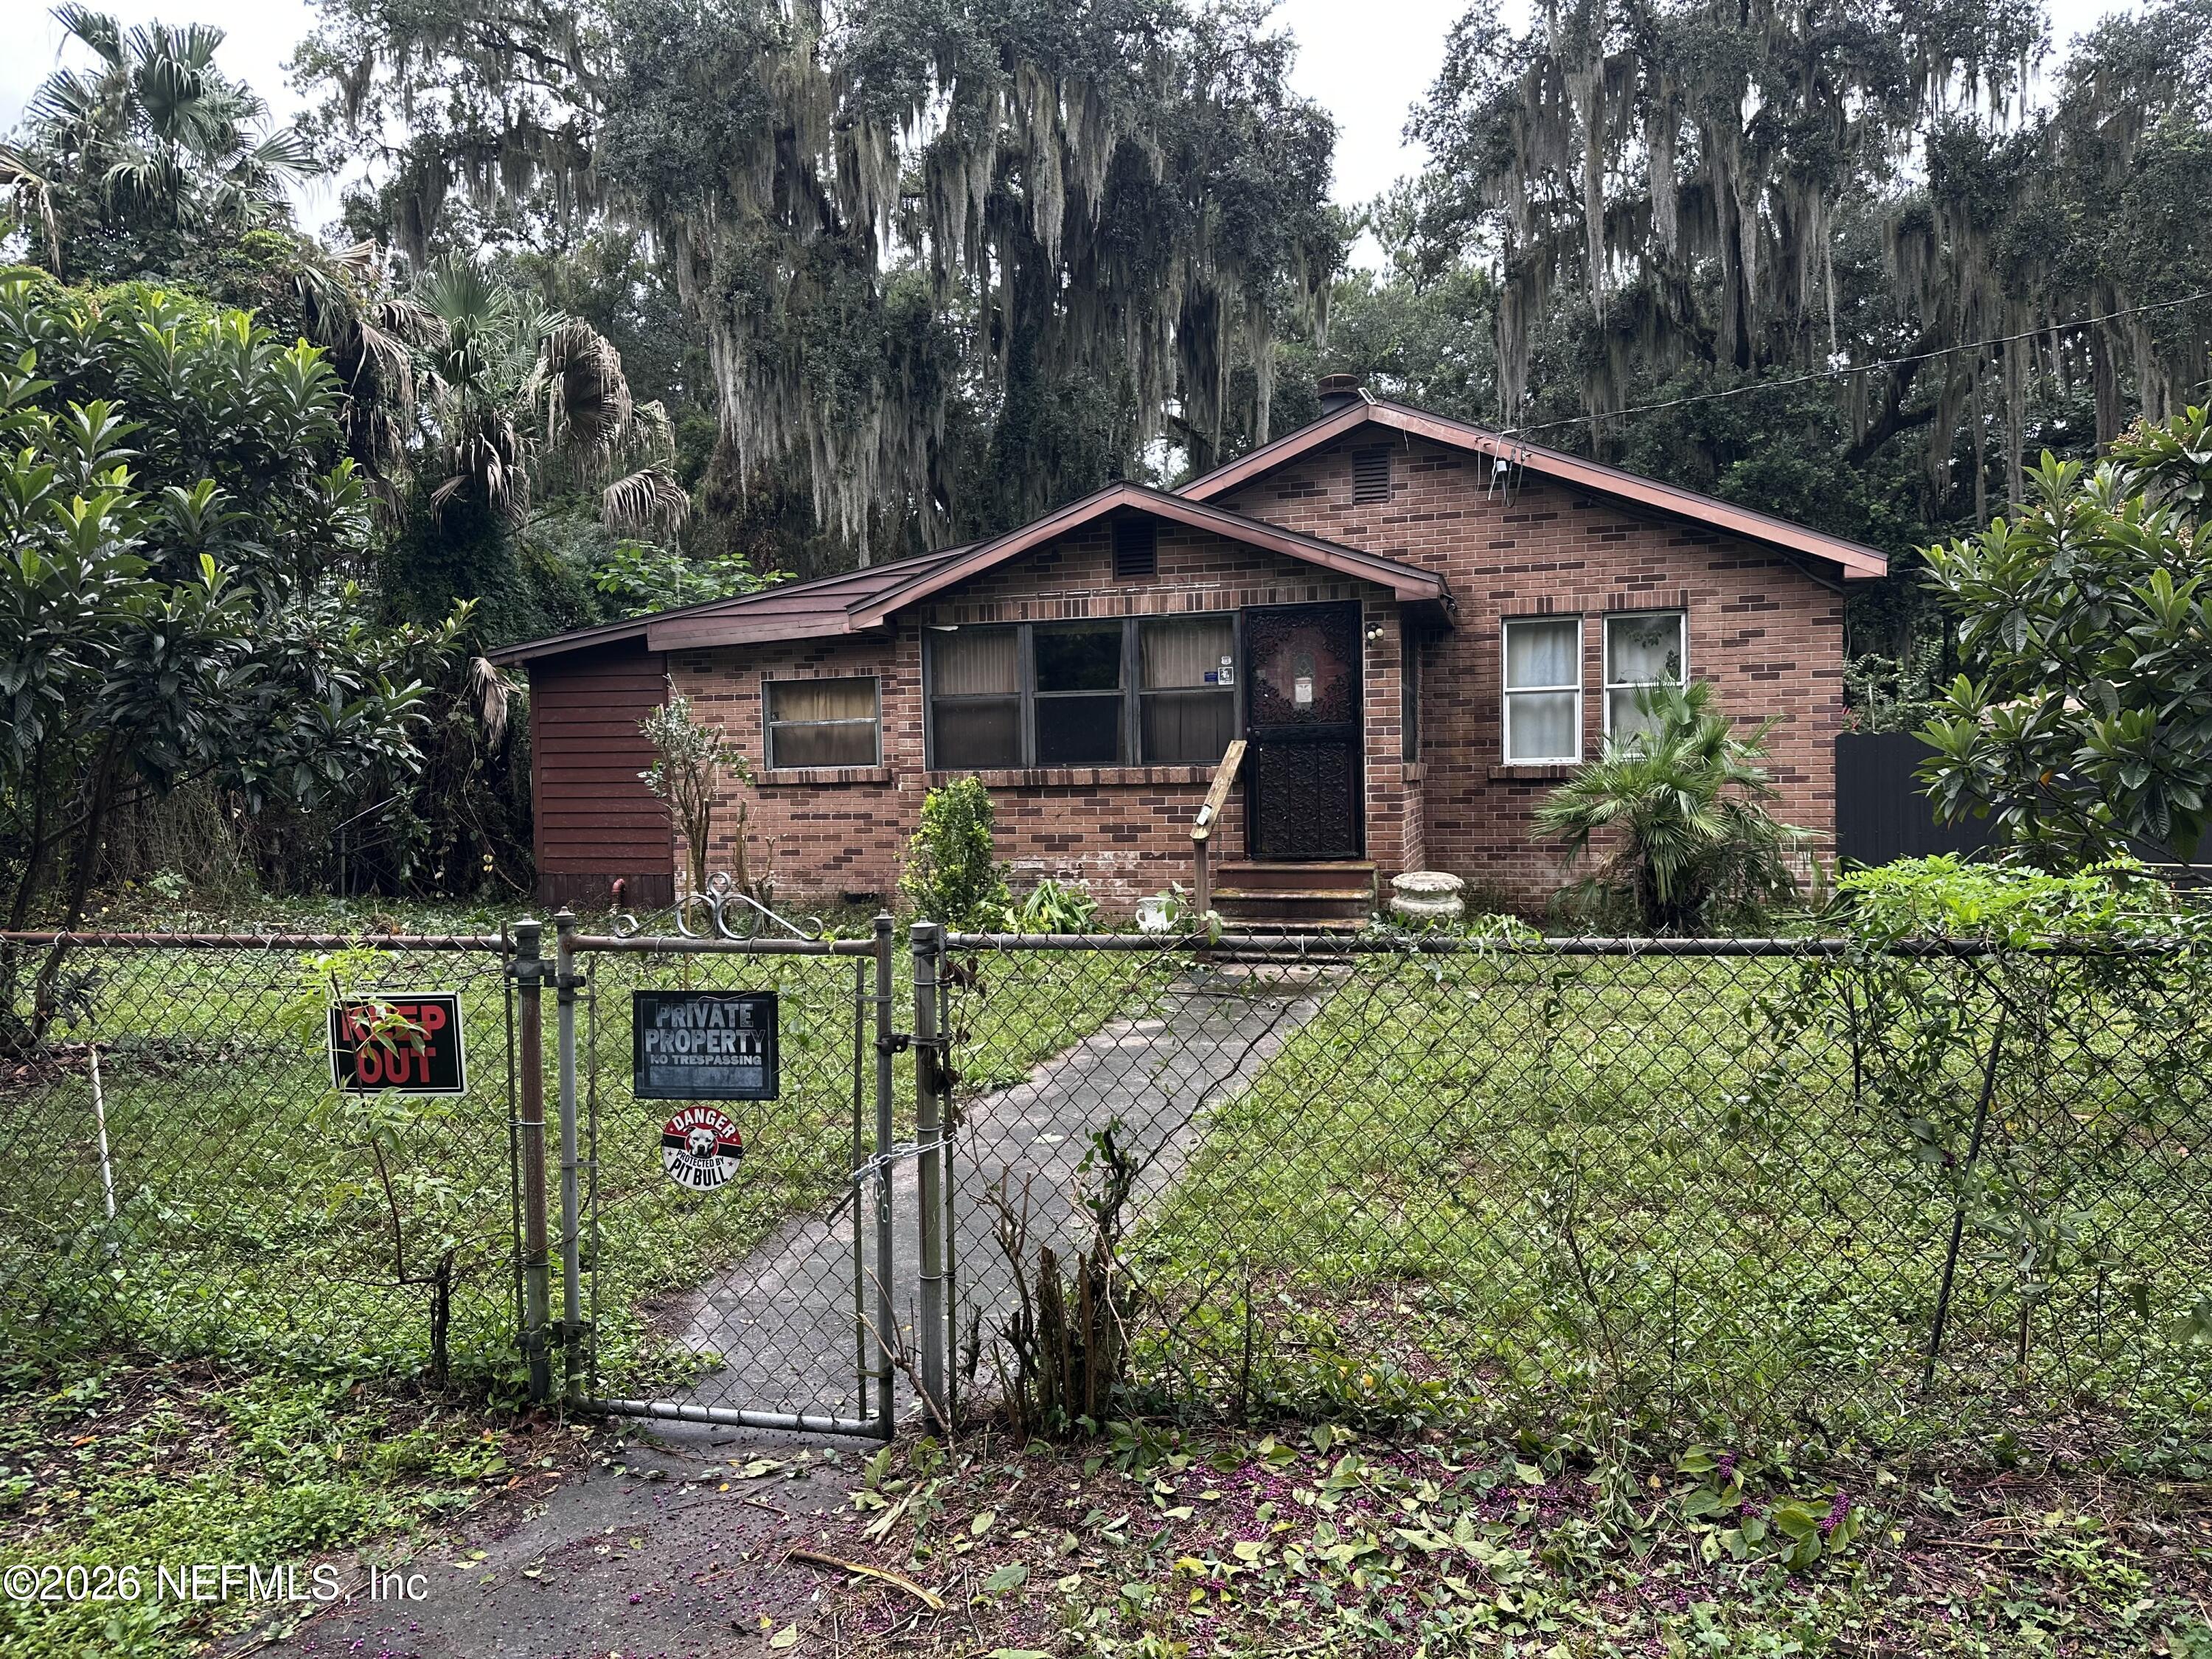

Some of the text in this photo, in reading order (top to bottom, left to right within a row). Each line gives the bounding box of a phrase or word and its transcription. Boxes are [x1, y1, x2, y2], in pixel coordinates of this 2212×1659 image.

[655, 1003, 754, 1028] PRIVATE
[645, 1029, 766, 1053] PROPERTY
[357, 1047, 437, 1084] OUT
[650, 1054, 762, 1065] NO TRESPASSING
[672, 1108, 737, 1138] DANGER
[669, 1157, 728, 1186] PIT BULL
[676, 1150, 725, 1168] PROTECTED BY
